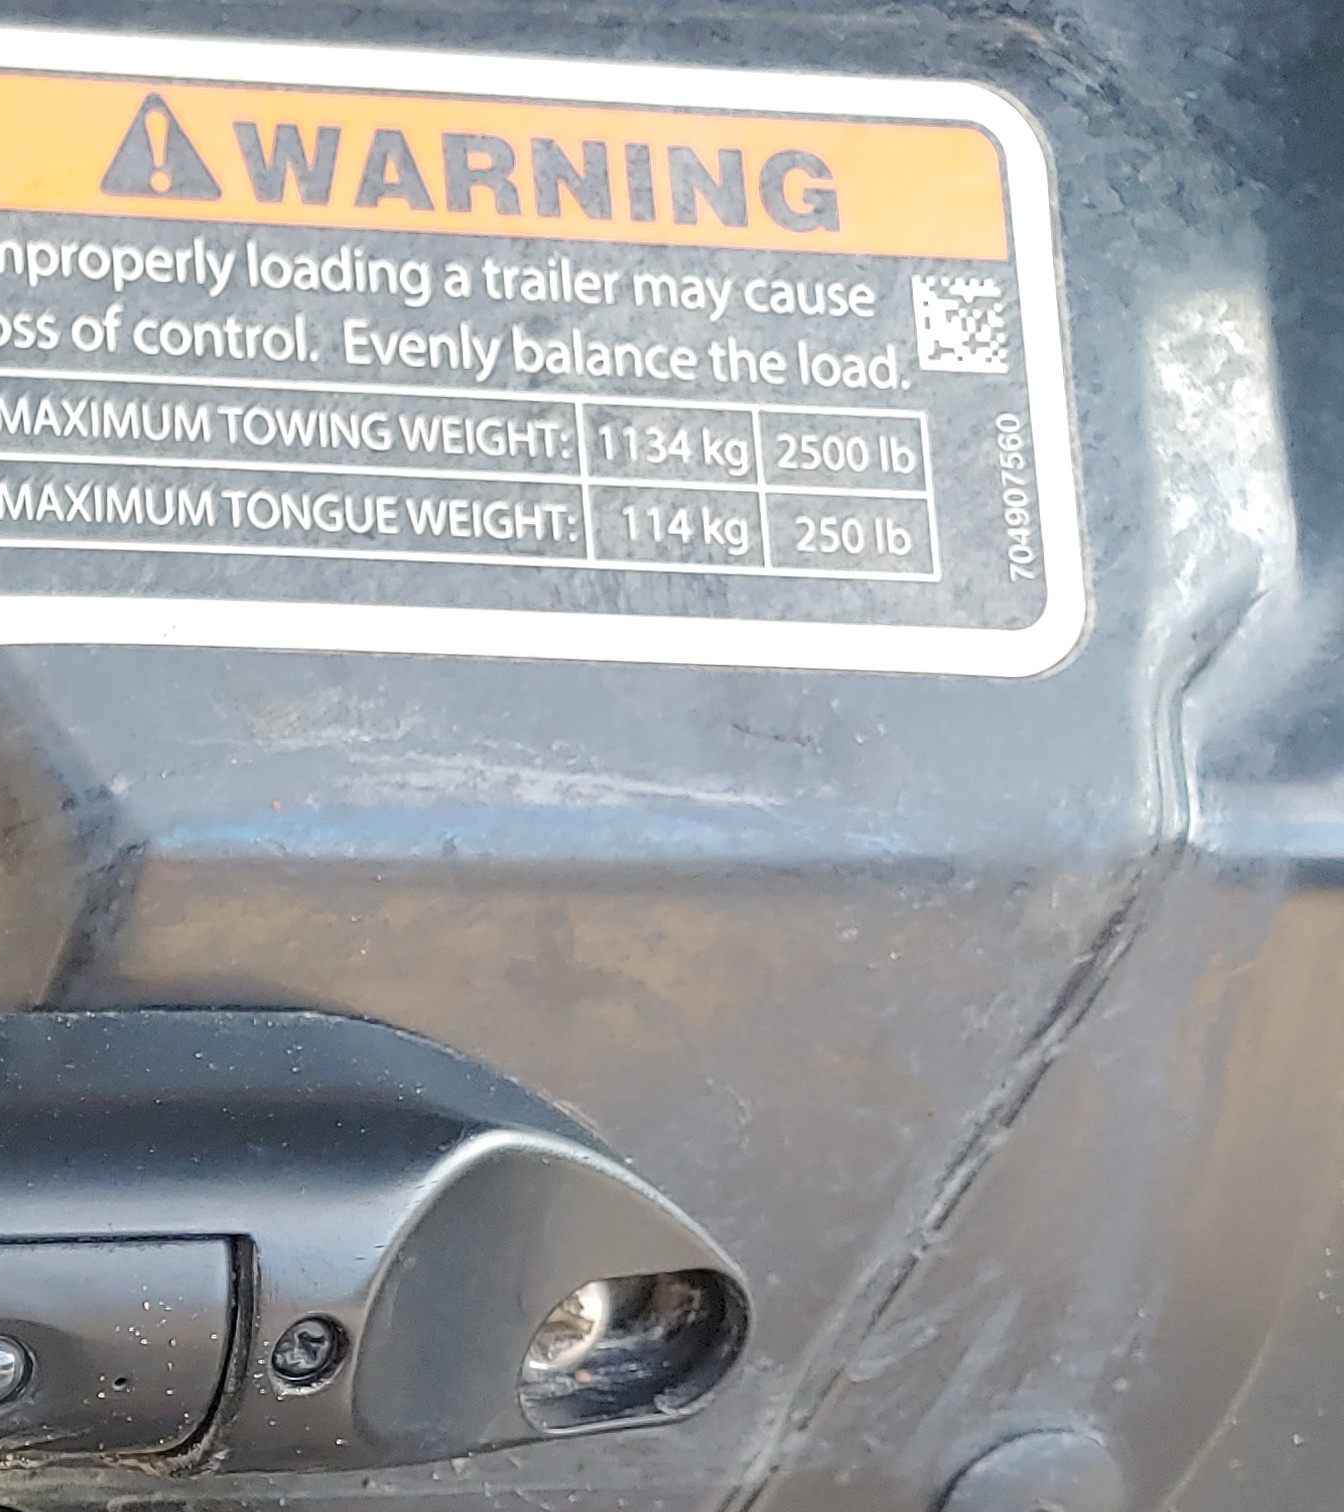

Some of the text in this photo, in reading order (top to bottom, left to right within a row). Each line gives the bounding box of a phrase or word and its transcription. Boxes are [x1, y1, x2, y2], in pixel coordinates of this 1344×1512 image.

[232, 121, 841, 233] WARNING
[247, 240, 430, 306] loading
[444, 265, 471, 298] a
[482, 257, 618, 304] trailer
[634, 274, 732, 321] may
[745, 280, 875, 318] cause
[71, 303, 124, 353] of
[133, 313, 319, 362] control.
[342, 319, 502, 381] Evenly
[513, 325, 698, 381] balance
[710, 341, 787, 385] the
[799, 345, 911, 390] load.
[218, 406, 392, 451] TOWING
[399, 415, 572, 459] WEIGHT:
[598, 425, 691, 463] 1134
[703, 429, 748, 476] kg
[776, 433, 869, 471] 2500
[879, 436, 914, 475] lb
[222, 490, 399, 534] TONGUE
[405, 500, 580, 543] WEIGHT:
[622, 508, 691, 543] 114
[703, 510, 749, 556] kg
[795, 517, 863, 553] 250
[875, 518, 912, 556] lb
[996, 412, 1036, 583] 704907560
